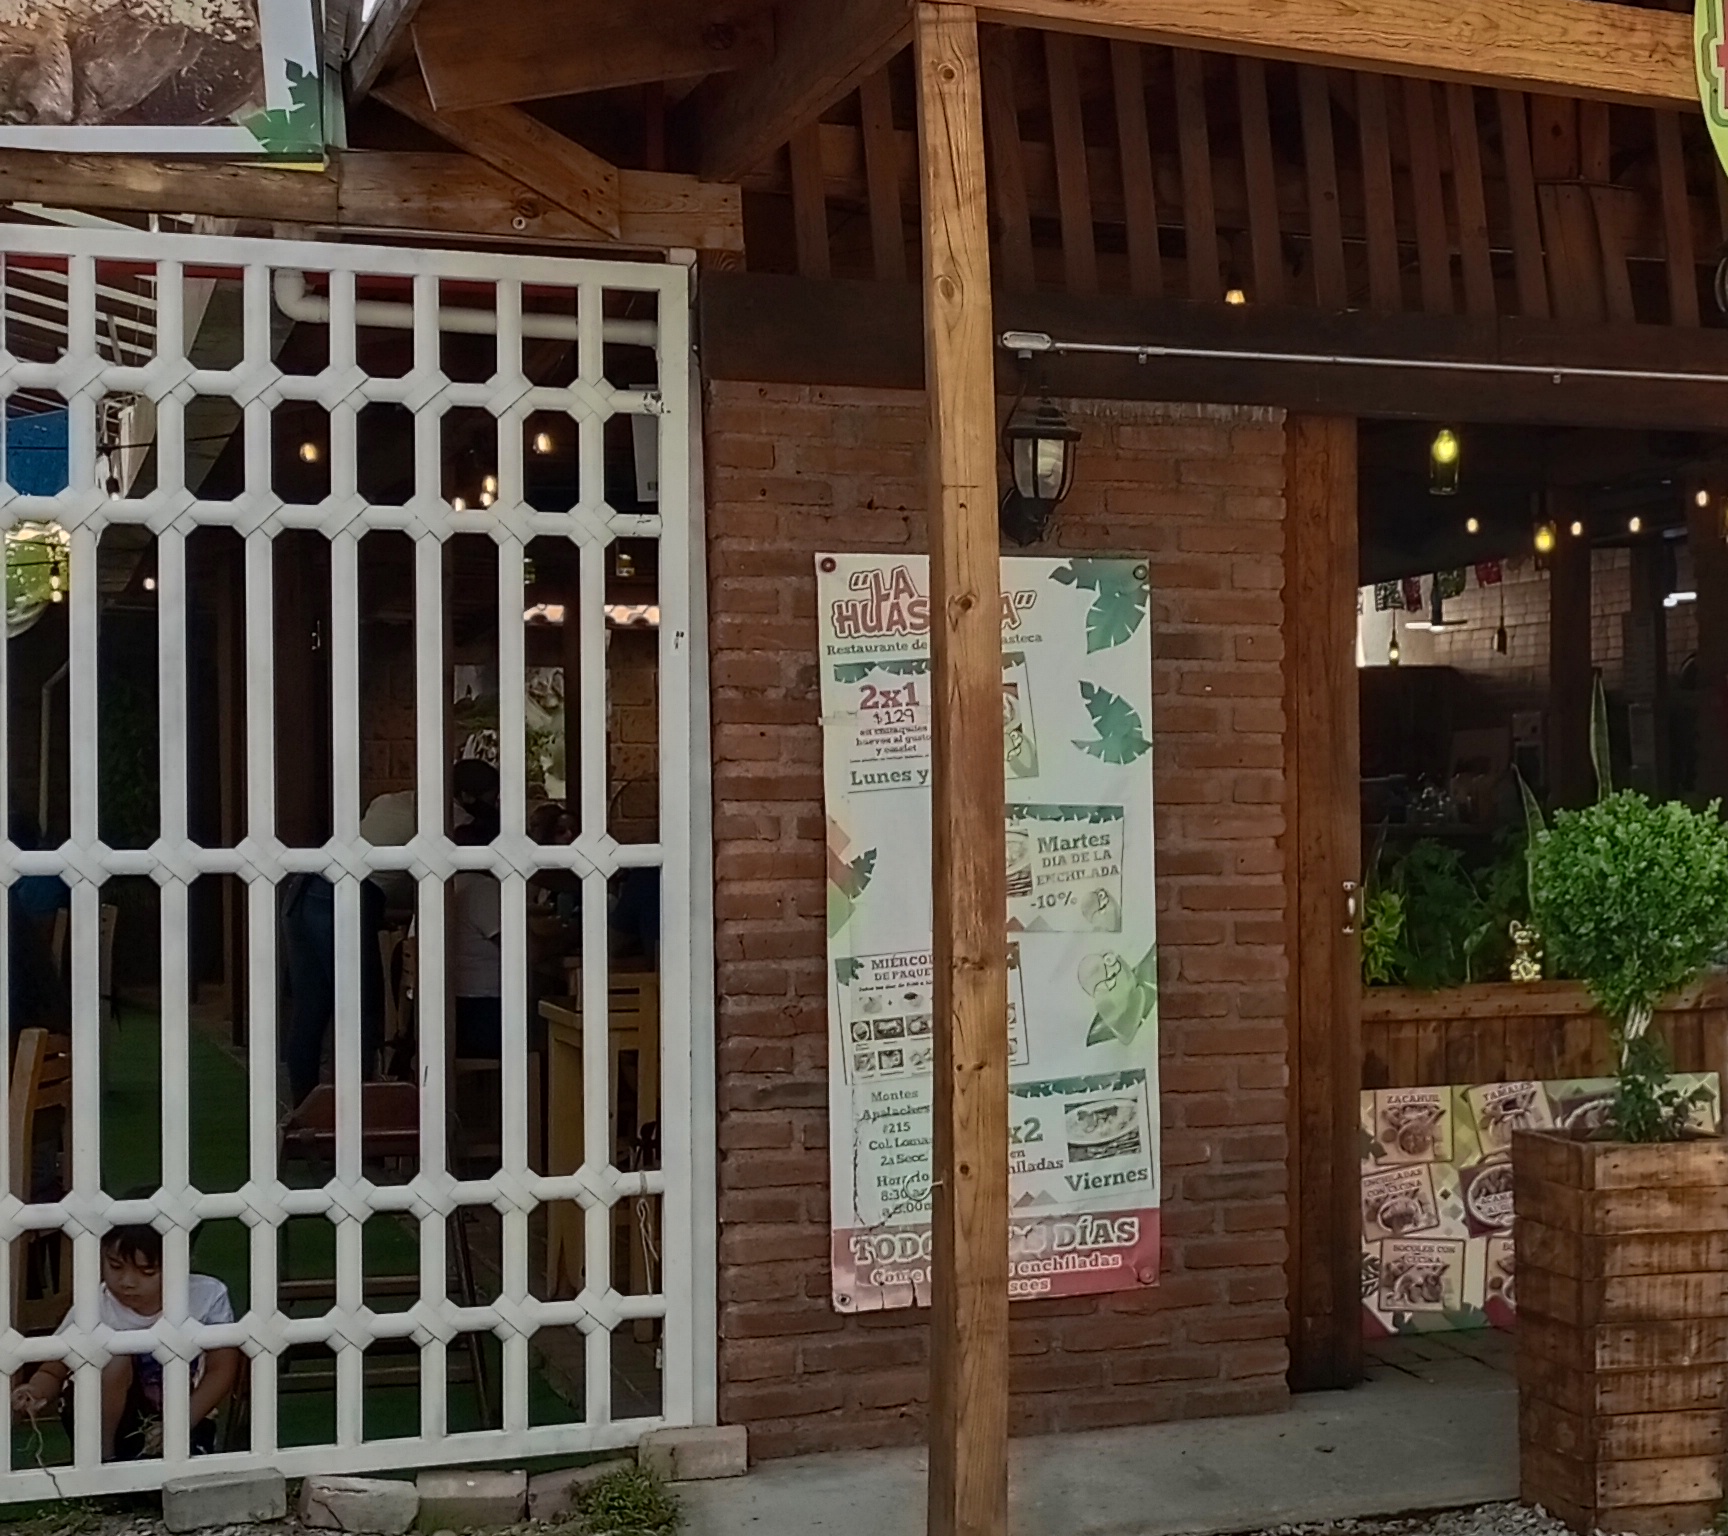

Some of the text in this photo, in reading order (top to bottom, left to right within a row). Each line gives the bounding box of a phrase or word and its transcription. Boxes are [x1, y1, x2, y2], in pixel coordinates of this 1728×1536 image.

[826, 642, 908, 655] Restaurante
[860, 682, 920, 710] 2x1
[850, 769, 929, 786] Lunes y
[1037, 833, 1111, 854] Martes
[1071, 851, 1091, 863] DE
[1094, 849, 1112, 861] LA
[1030, 890, 1078, 909] -10%
[892, 967, 932, 980] PAQUE
[871, 1090, 919, 1102] Montes
[1008, 1117, 1043, 1144] x2
[1064, 1168, 1148, 1191] Viernes
[1054, 1216, 1139, 1250] DÍAS
[1008, 1277, 1051, 1296] sees
